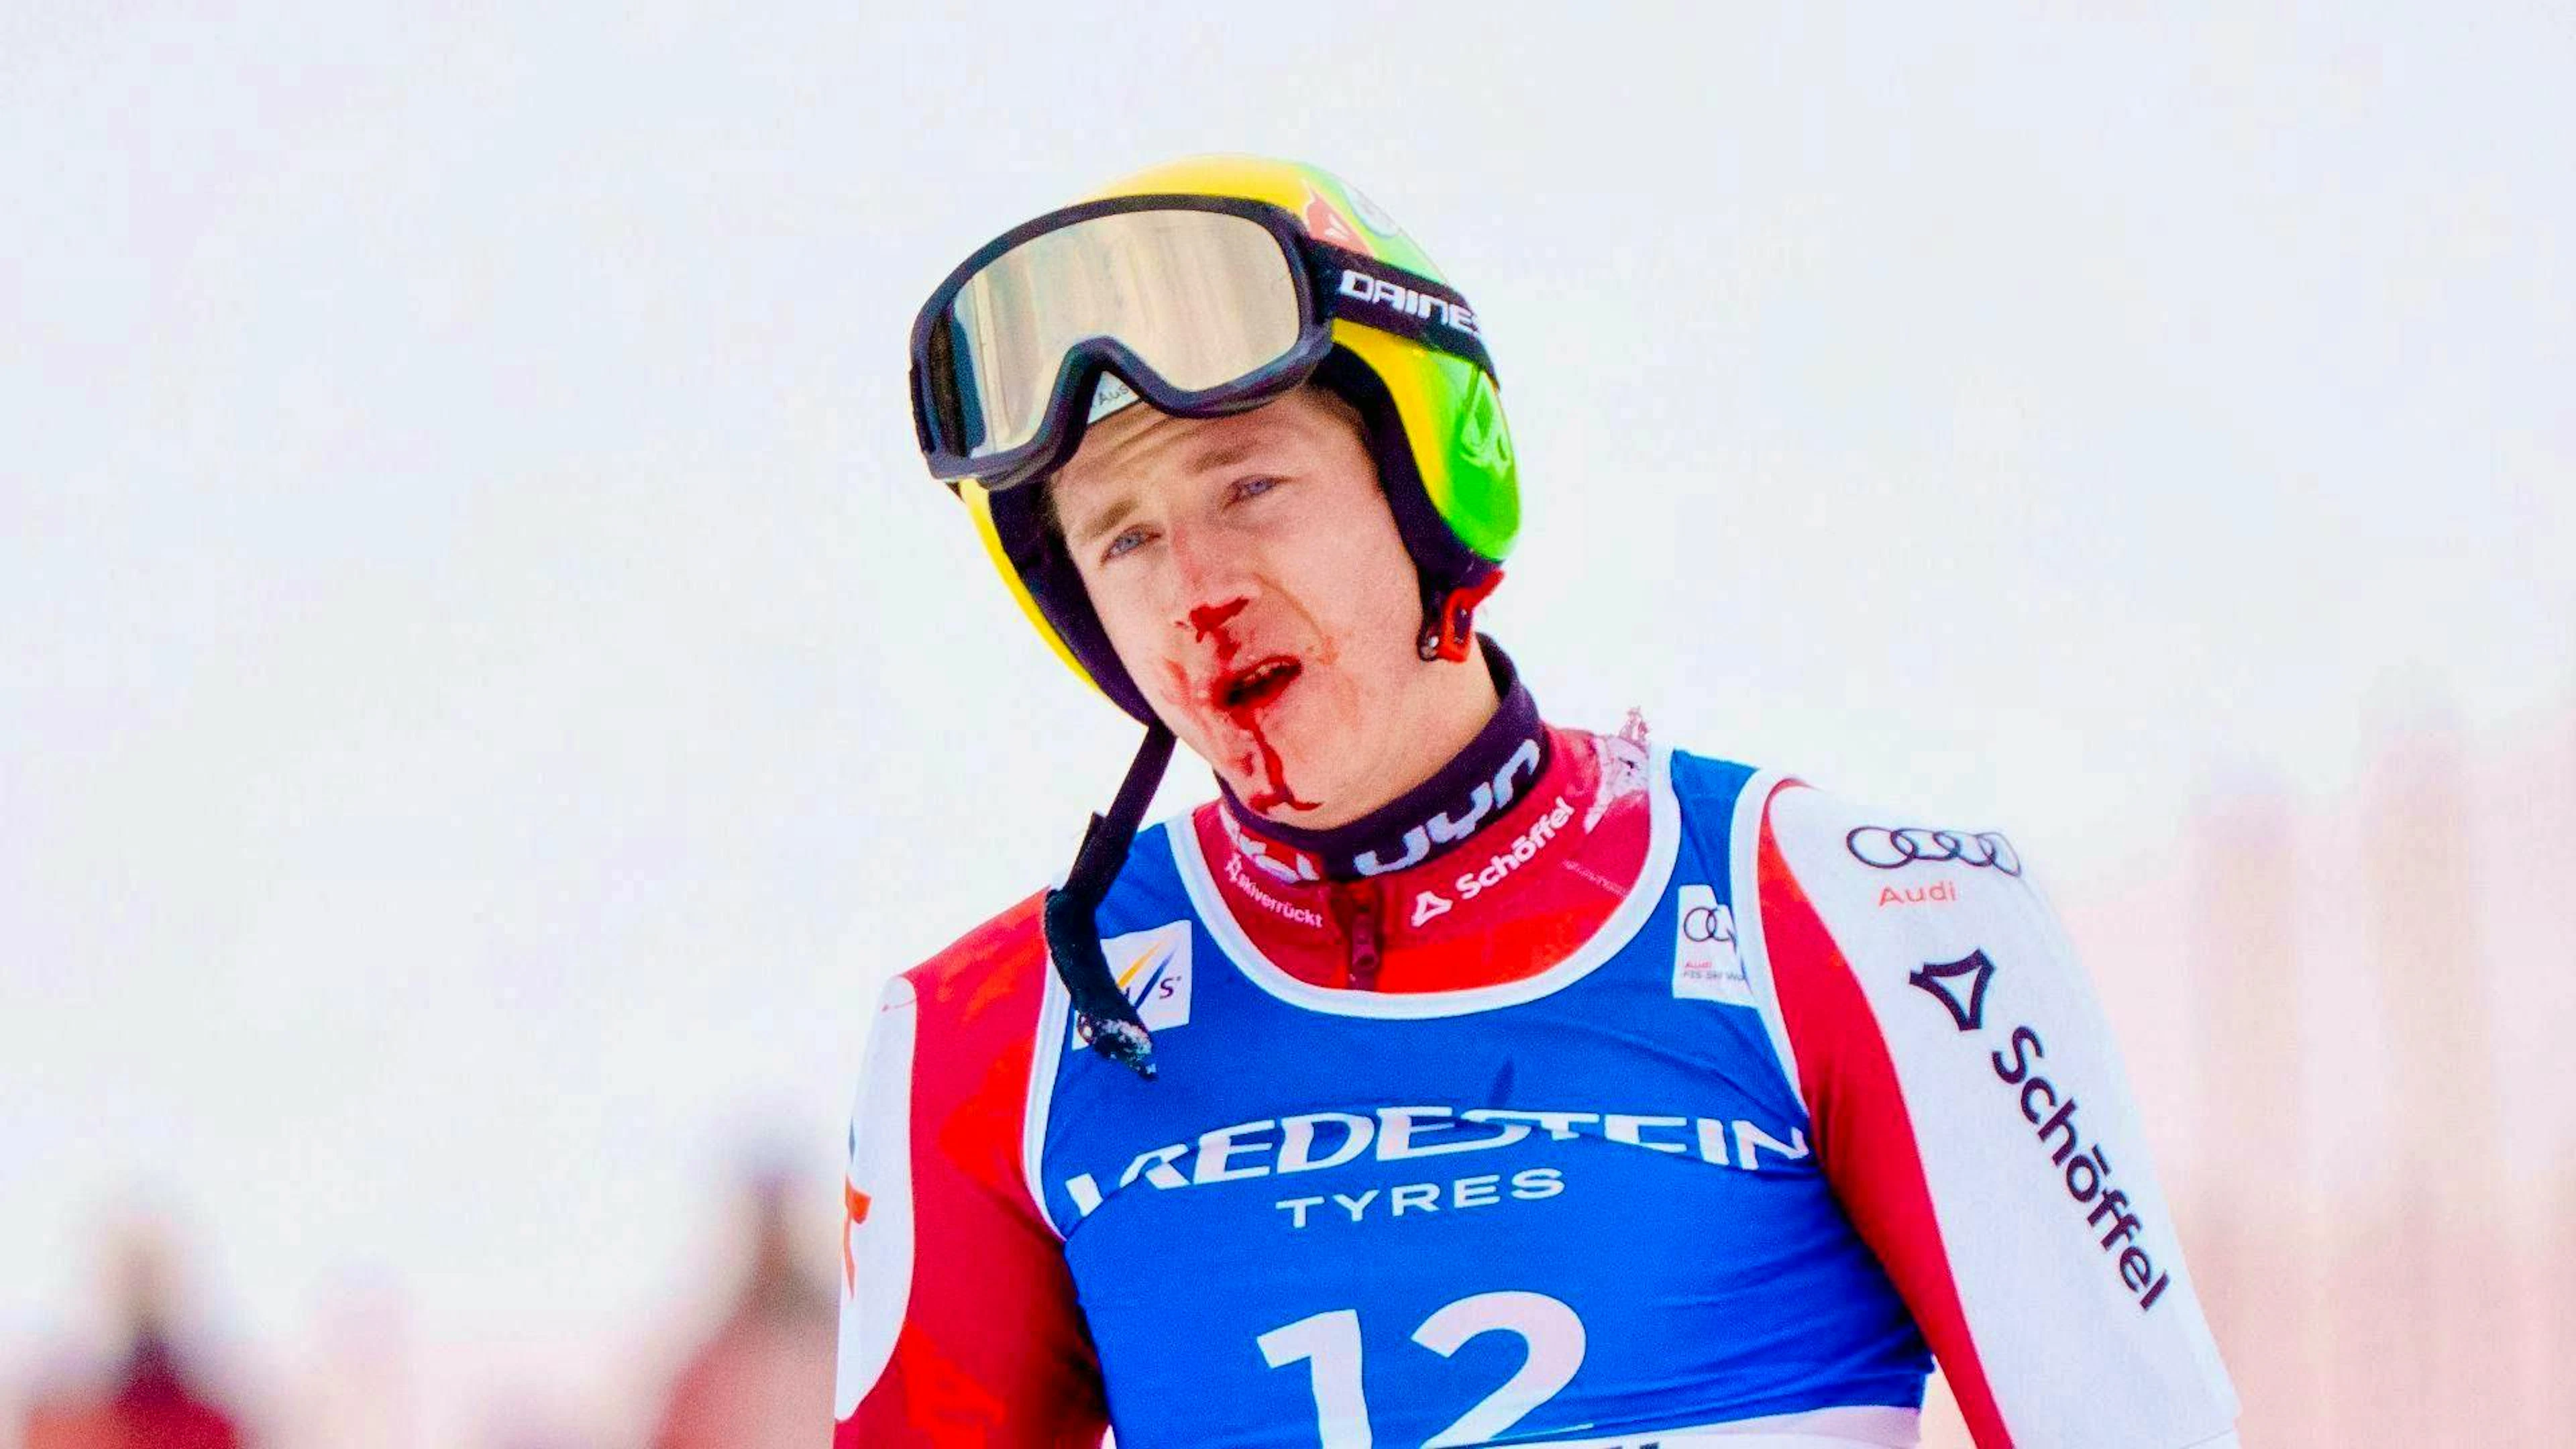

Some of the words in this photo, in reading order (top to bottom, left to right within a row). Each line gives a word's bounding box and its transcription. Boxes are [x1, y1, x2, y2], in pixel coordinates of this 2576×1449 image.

[1339, 268, 1479, 335] DAINE
[1879, 880, 1956, 907] Audi
[1275, 1167, 1566, 1228] TYRES
[1256, 1291, 1587, 1449] 12
